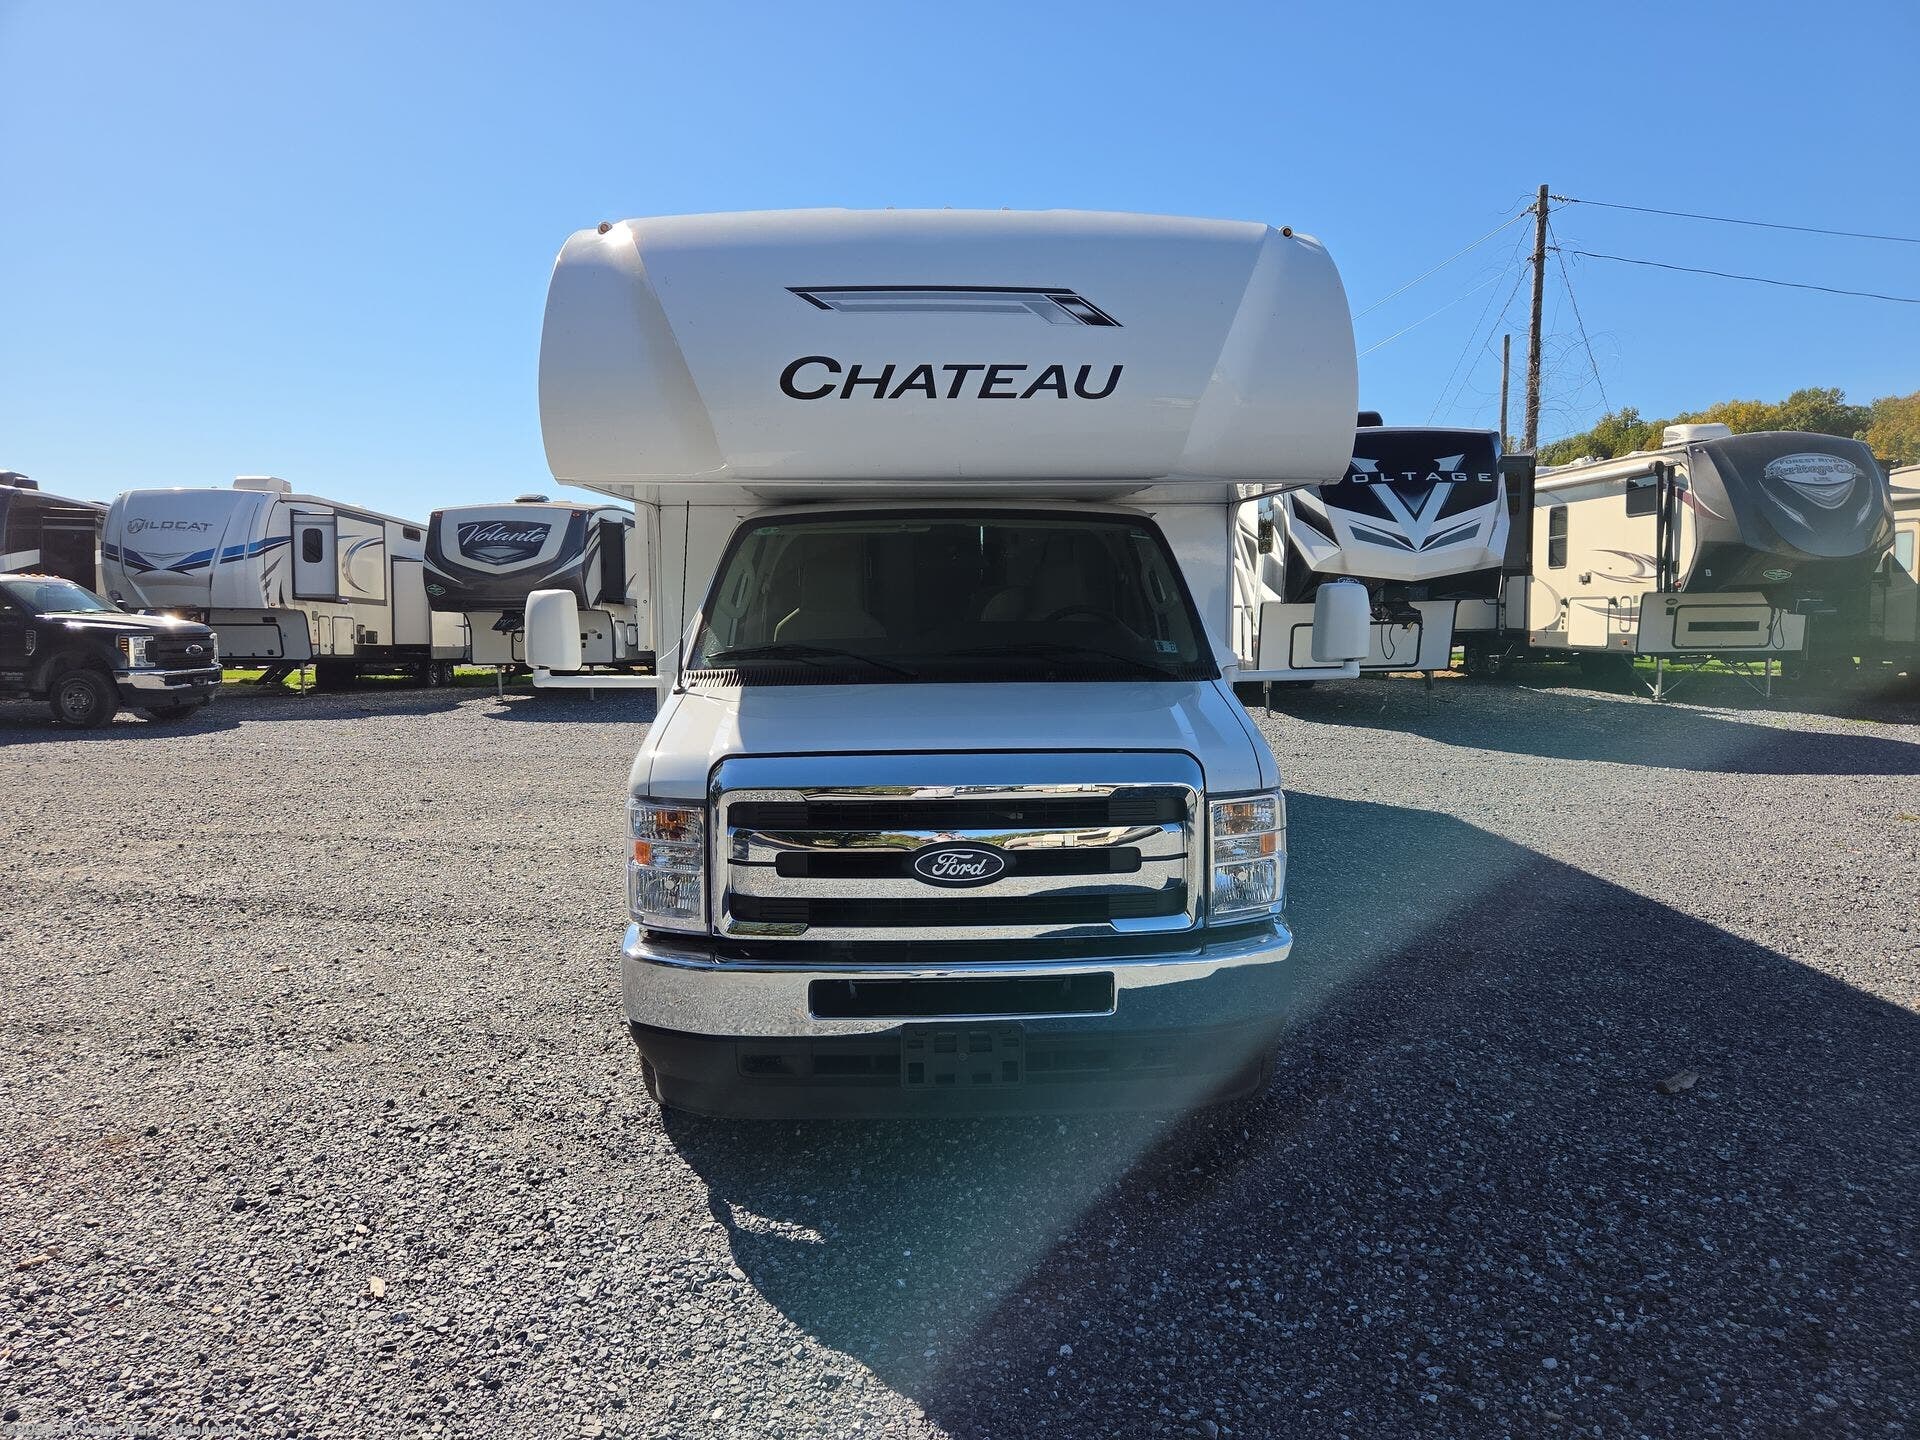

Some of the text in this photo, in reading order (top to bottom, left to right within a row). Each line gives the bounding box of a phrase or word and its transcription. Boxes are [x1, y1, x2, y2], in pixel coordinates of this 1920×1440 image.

[779, 355, 1124, 400] CHATEAU
[1351, 471, 1493, 483] OLTAGE
[457, 522, 550, 546] Volante
[931, 853, 986, 876] Ford
